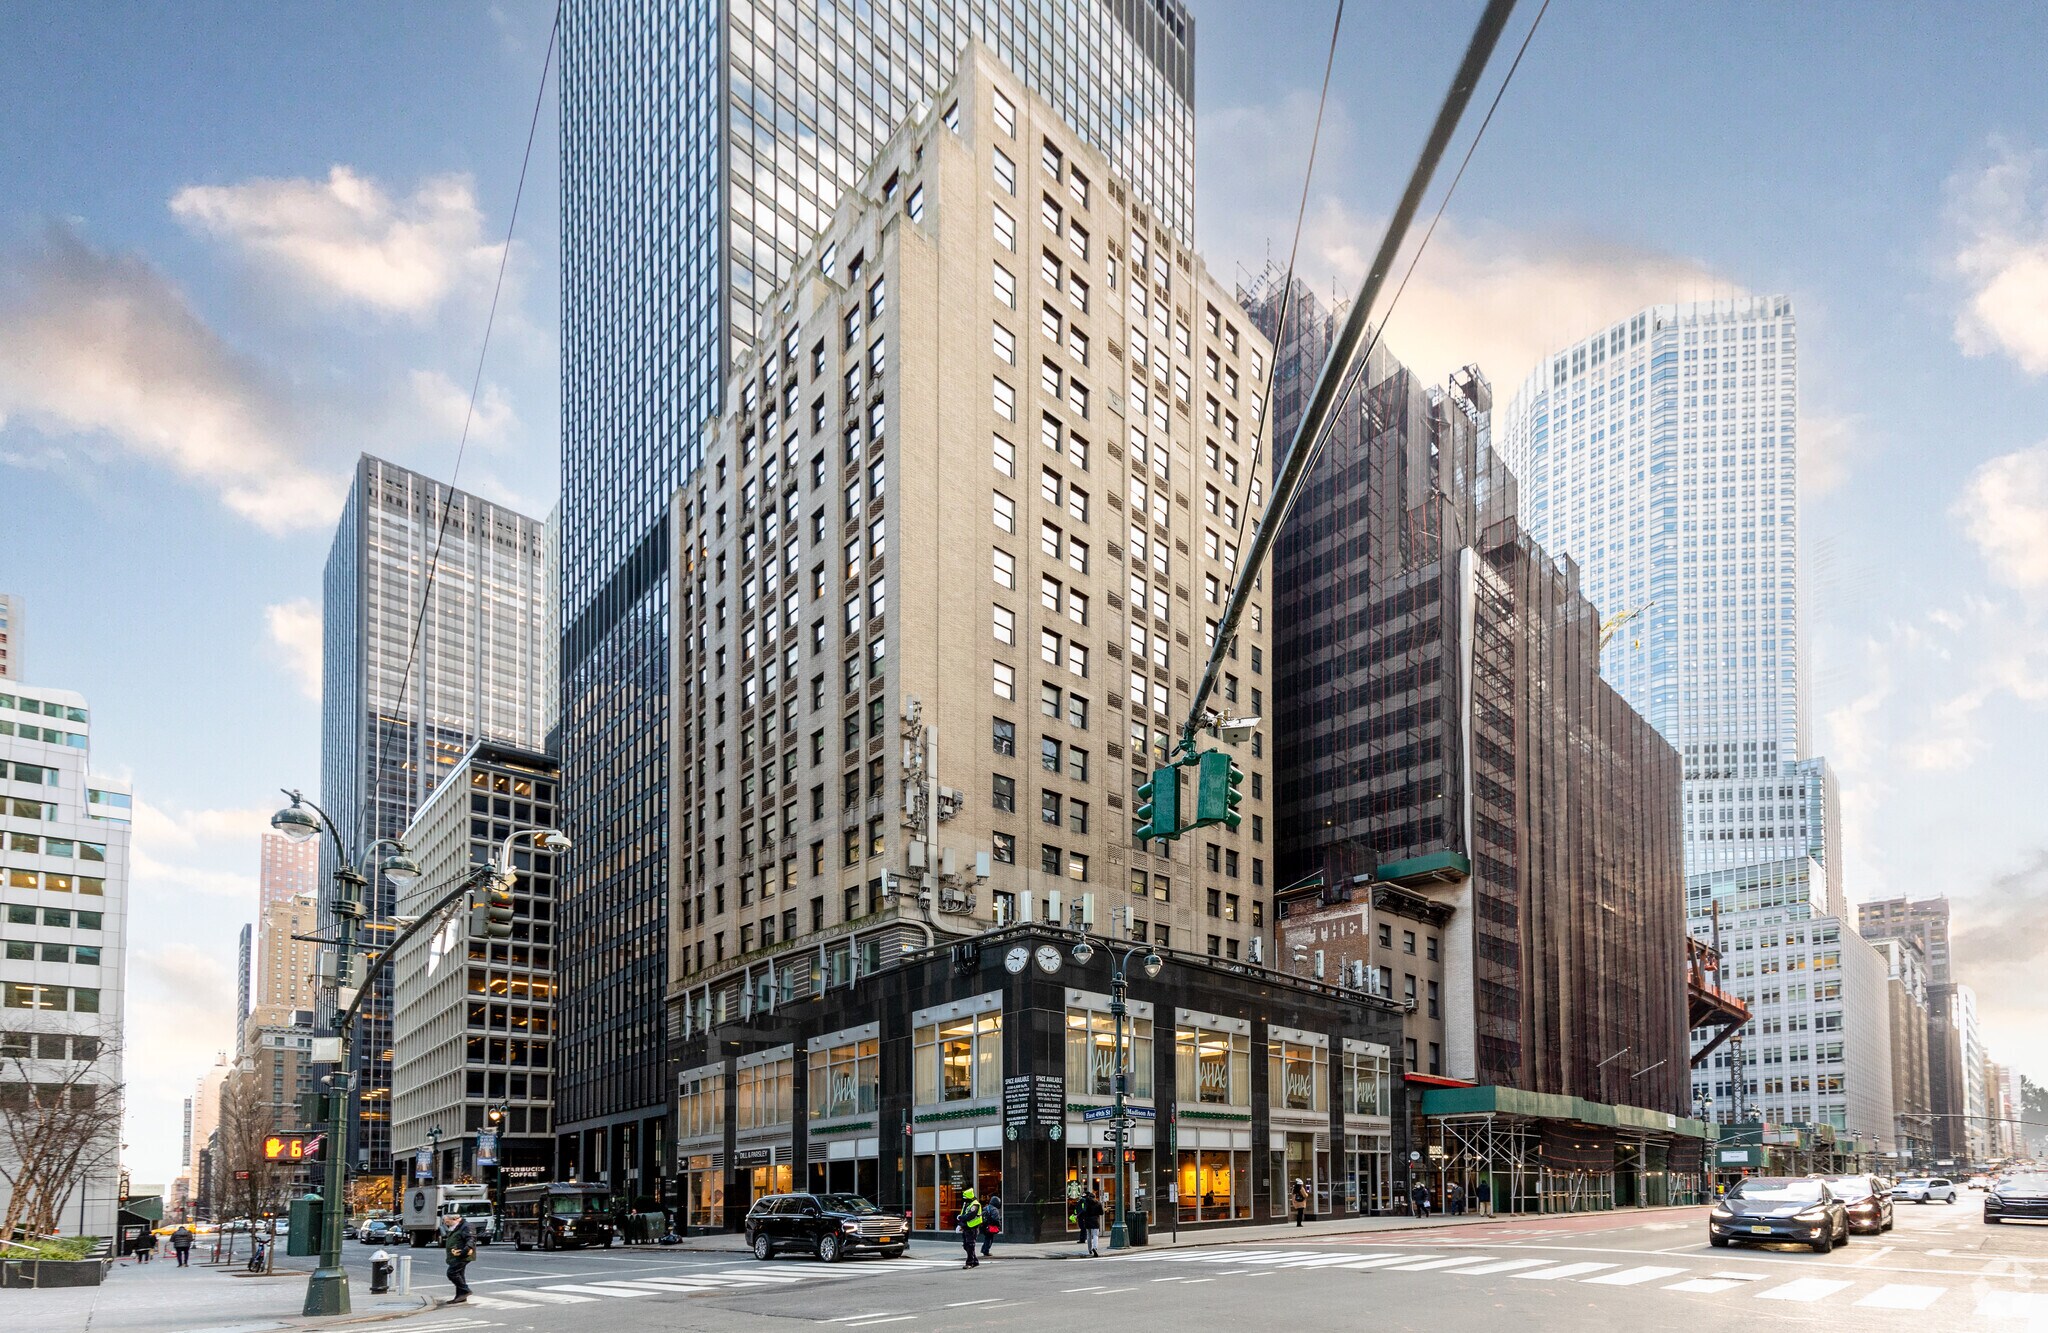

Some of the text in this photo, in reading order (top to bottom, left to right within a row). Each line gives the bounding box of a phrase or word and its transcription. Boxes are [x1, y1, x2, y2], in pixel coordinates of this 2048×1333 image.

[1199, 1062, 1227, 1088] AHAG
[1285, 1063, 1312, 1101] SAHAG
[1126, 1108, 1146, 1116] Madison
[291, 1140, 302, 1158] 6
[750, 1150, 768, 1158] PARSLEY
